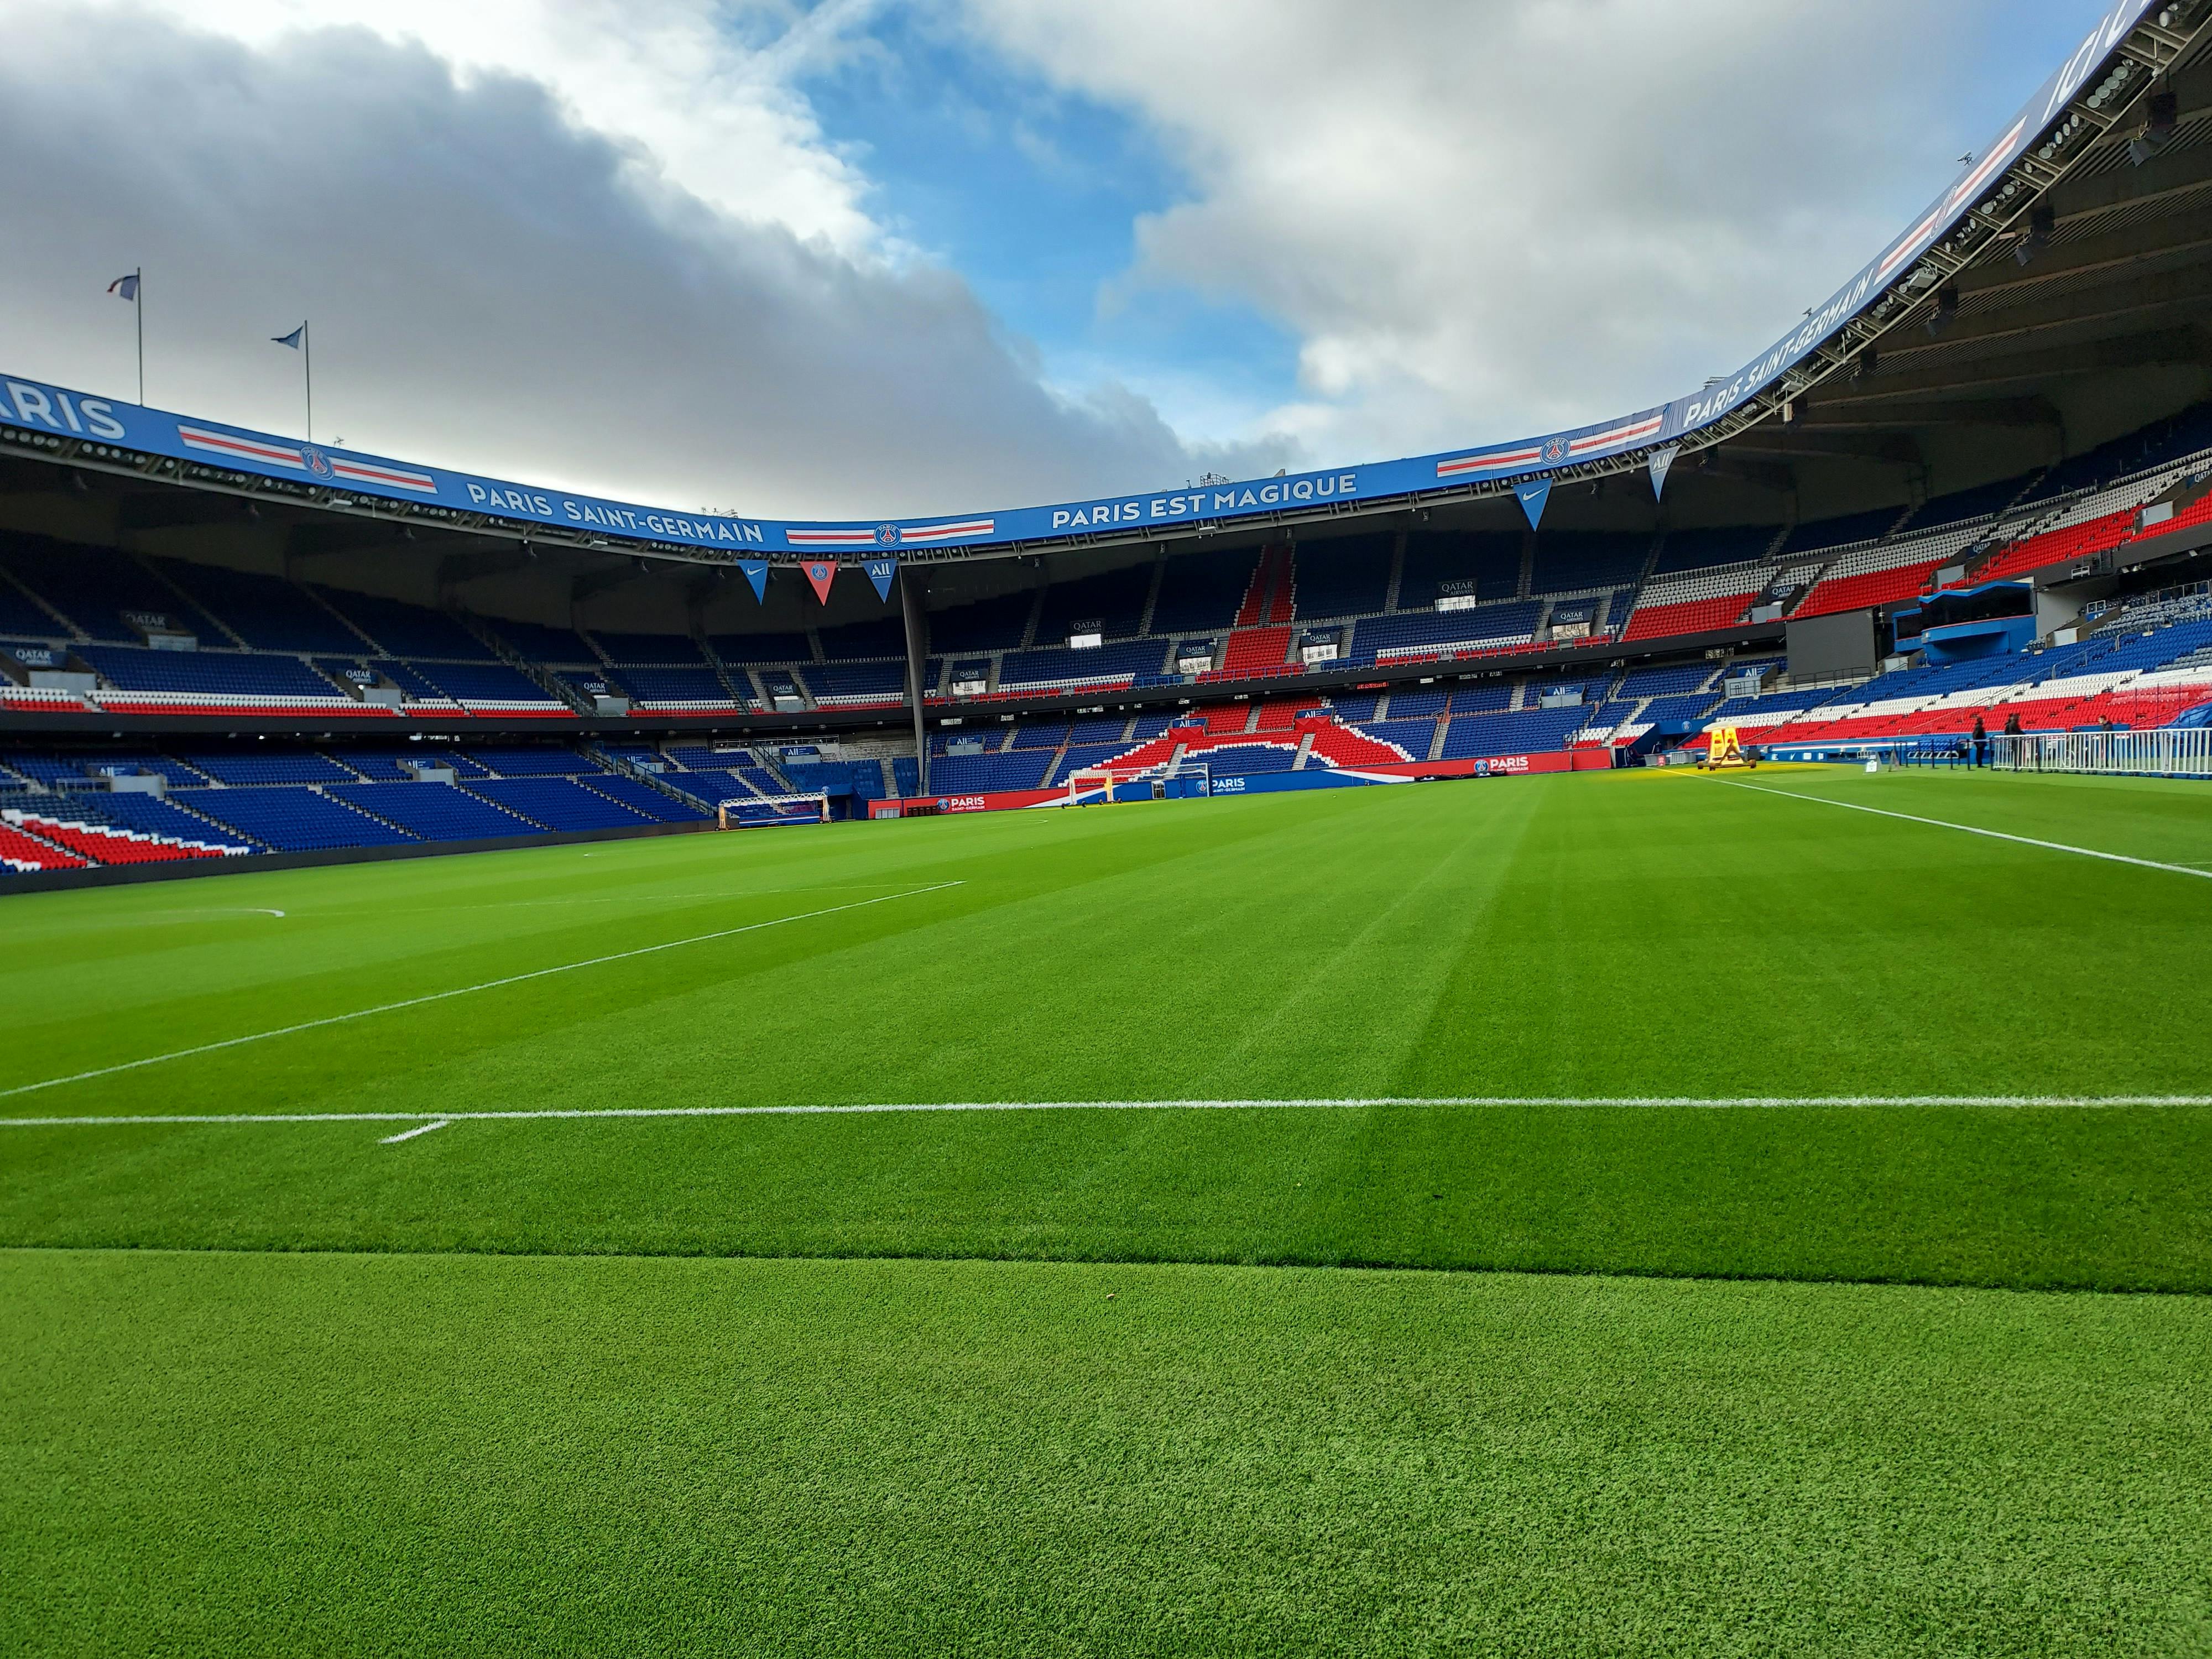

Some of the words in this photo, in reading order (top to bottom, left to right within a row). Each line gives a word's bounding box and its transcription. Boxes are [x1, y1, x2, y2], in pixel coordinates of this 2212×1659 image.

[1683, 377, 1743, 428] PARIS
[1744, 268, 1874, 392] SAINT-GERMAIN
[0, 380, 126, 440] RIS
[1052, 502, 1140, 529] PARIS
[1150, 494, 1206, 518] EST
[1214, 473, 1357, 510] MAGIQUE
[466, 483, 553, 516] PARIS
[562, 500, 764, 542] SAINT-GERMAIN
[1441, 581, 1473, 593] QATAR
[1772, 586, 1795, 595] QATAR
[1560, 612, 1583, 620] QATAR
[1073, 620, 1102, 632] QATAR
[1186, 645, 1206, 654] QATAR
[583, 682, 606, 691] QATAR
[1490, 756, 1529, 769] PARIS
[1212, 778, 1245, 789] PARIS
[951, 796, 985, 807] PARIS
